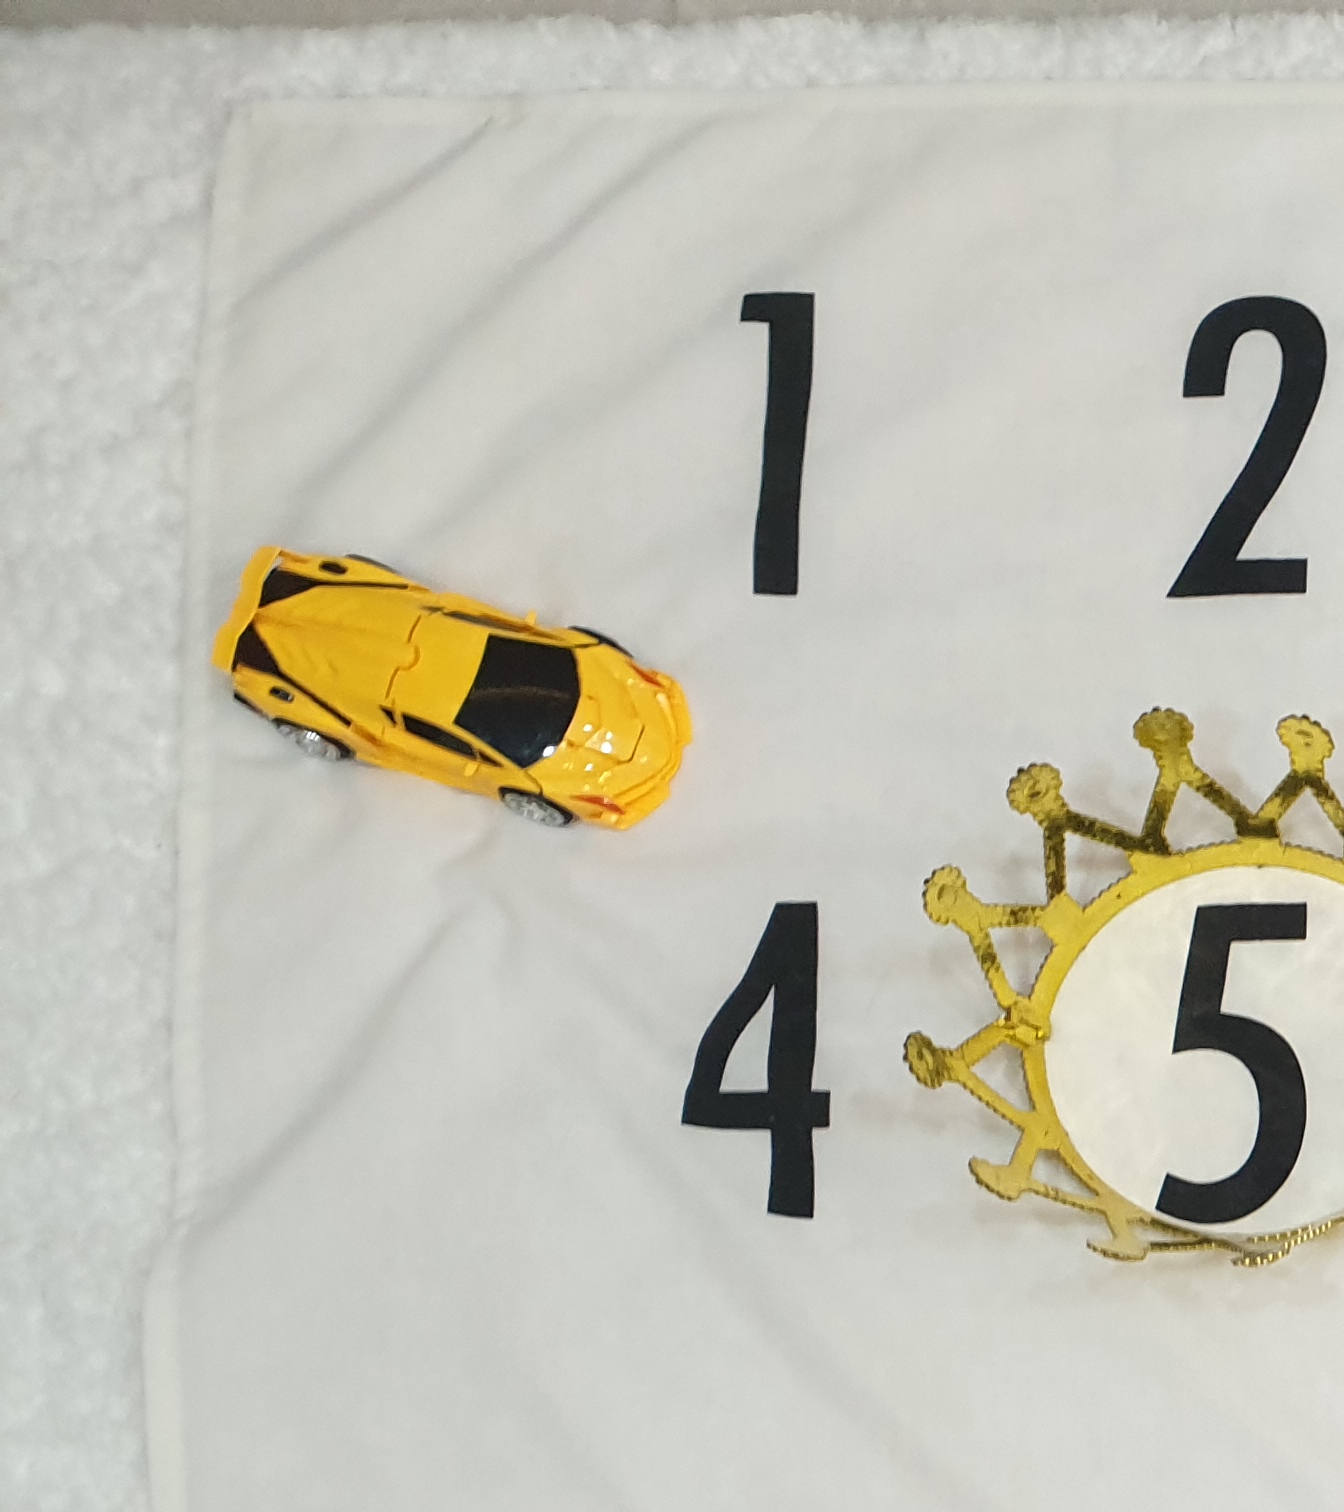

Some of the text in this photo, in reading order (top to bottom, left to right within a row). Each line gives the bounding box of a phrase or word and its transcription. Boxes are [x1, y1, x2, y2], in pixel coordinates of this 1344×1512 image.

[740, 292, 815, 596] 1
[1166, 296, 1327, 598] 2
[682, 902, 831, 1219] 4
[1155, 902, 1308, 1224] 5
